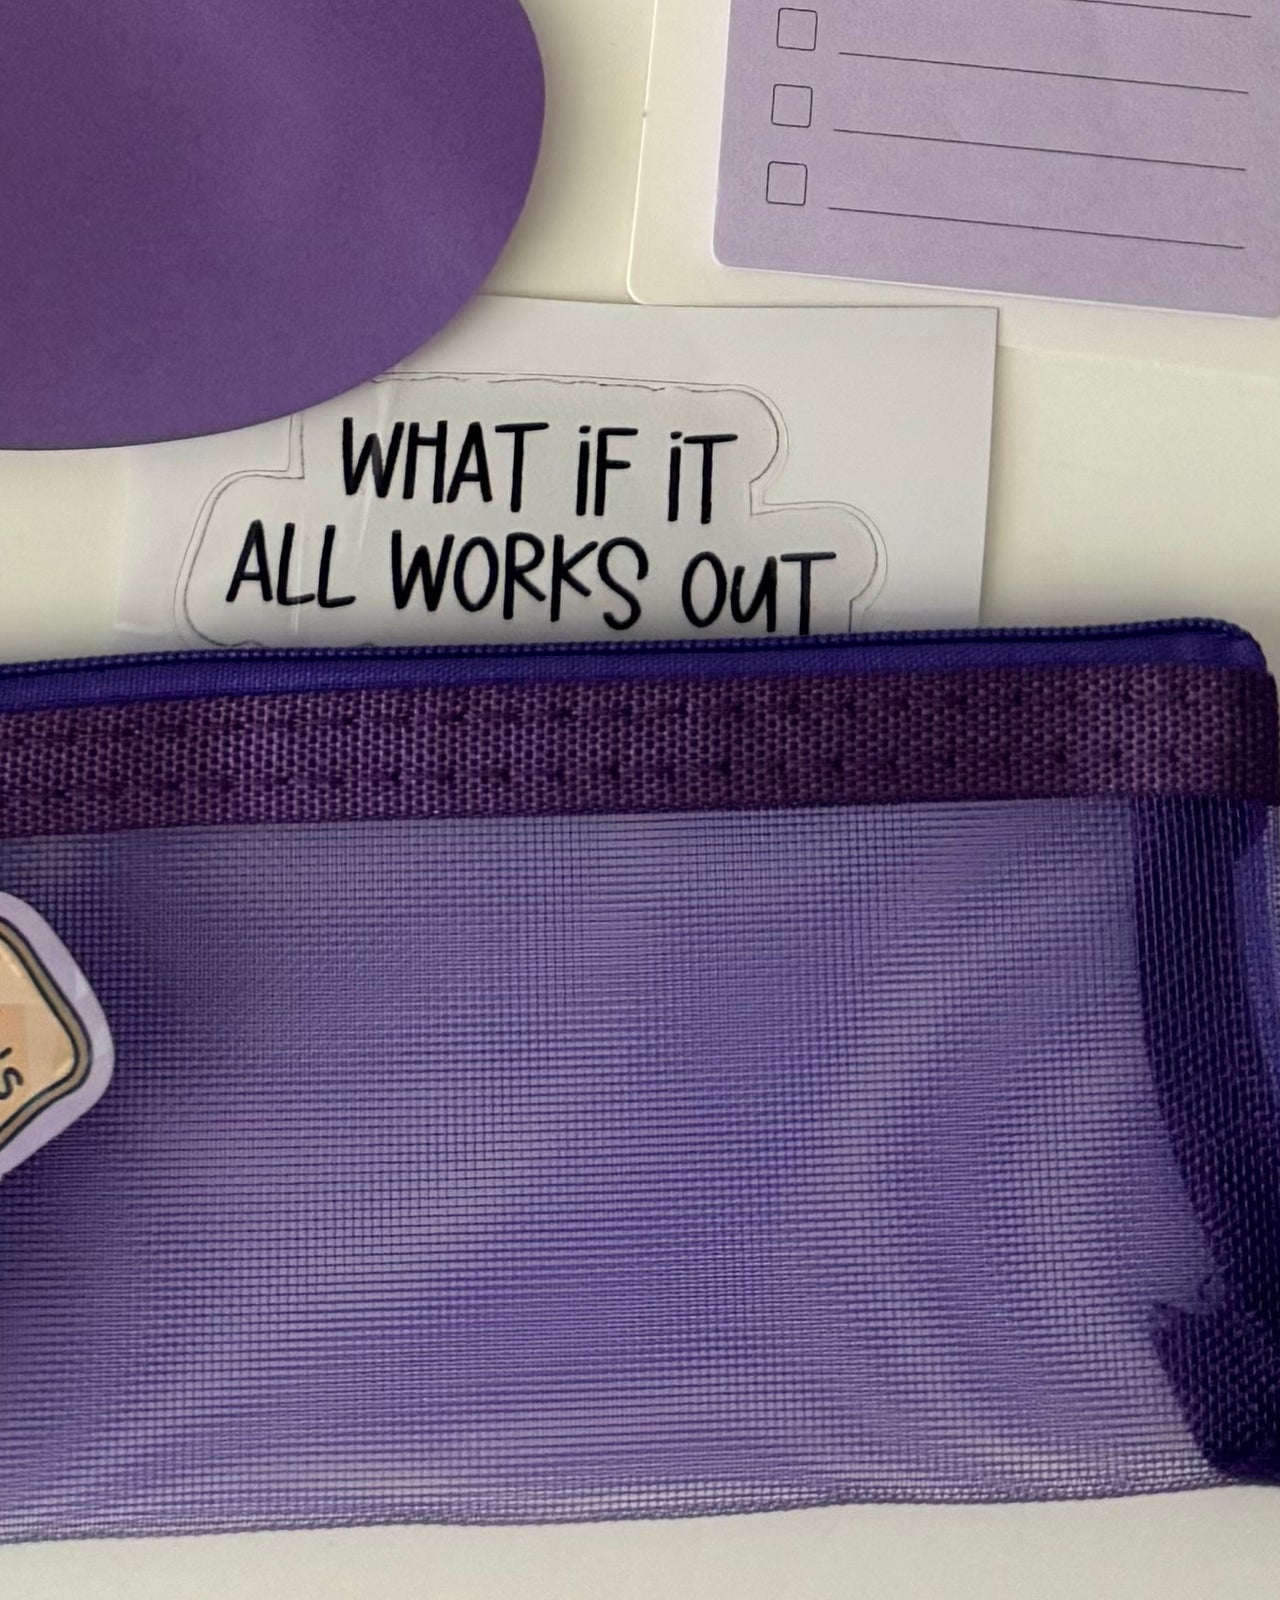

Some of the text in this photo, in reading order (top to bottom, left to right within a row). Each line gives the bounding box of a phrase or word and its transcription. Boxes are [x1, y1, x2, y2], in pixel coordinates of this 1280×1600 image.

[340, 415, 550, 514] WHAT
[223, 518, 357, 610] ALL
[390, 529, 650, 633] WORKS
